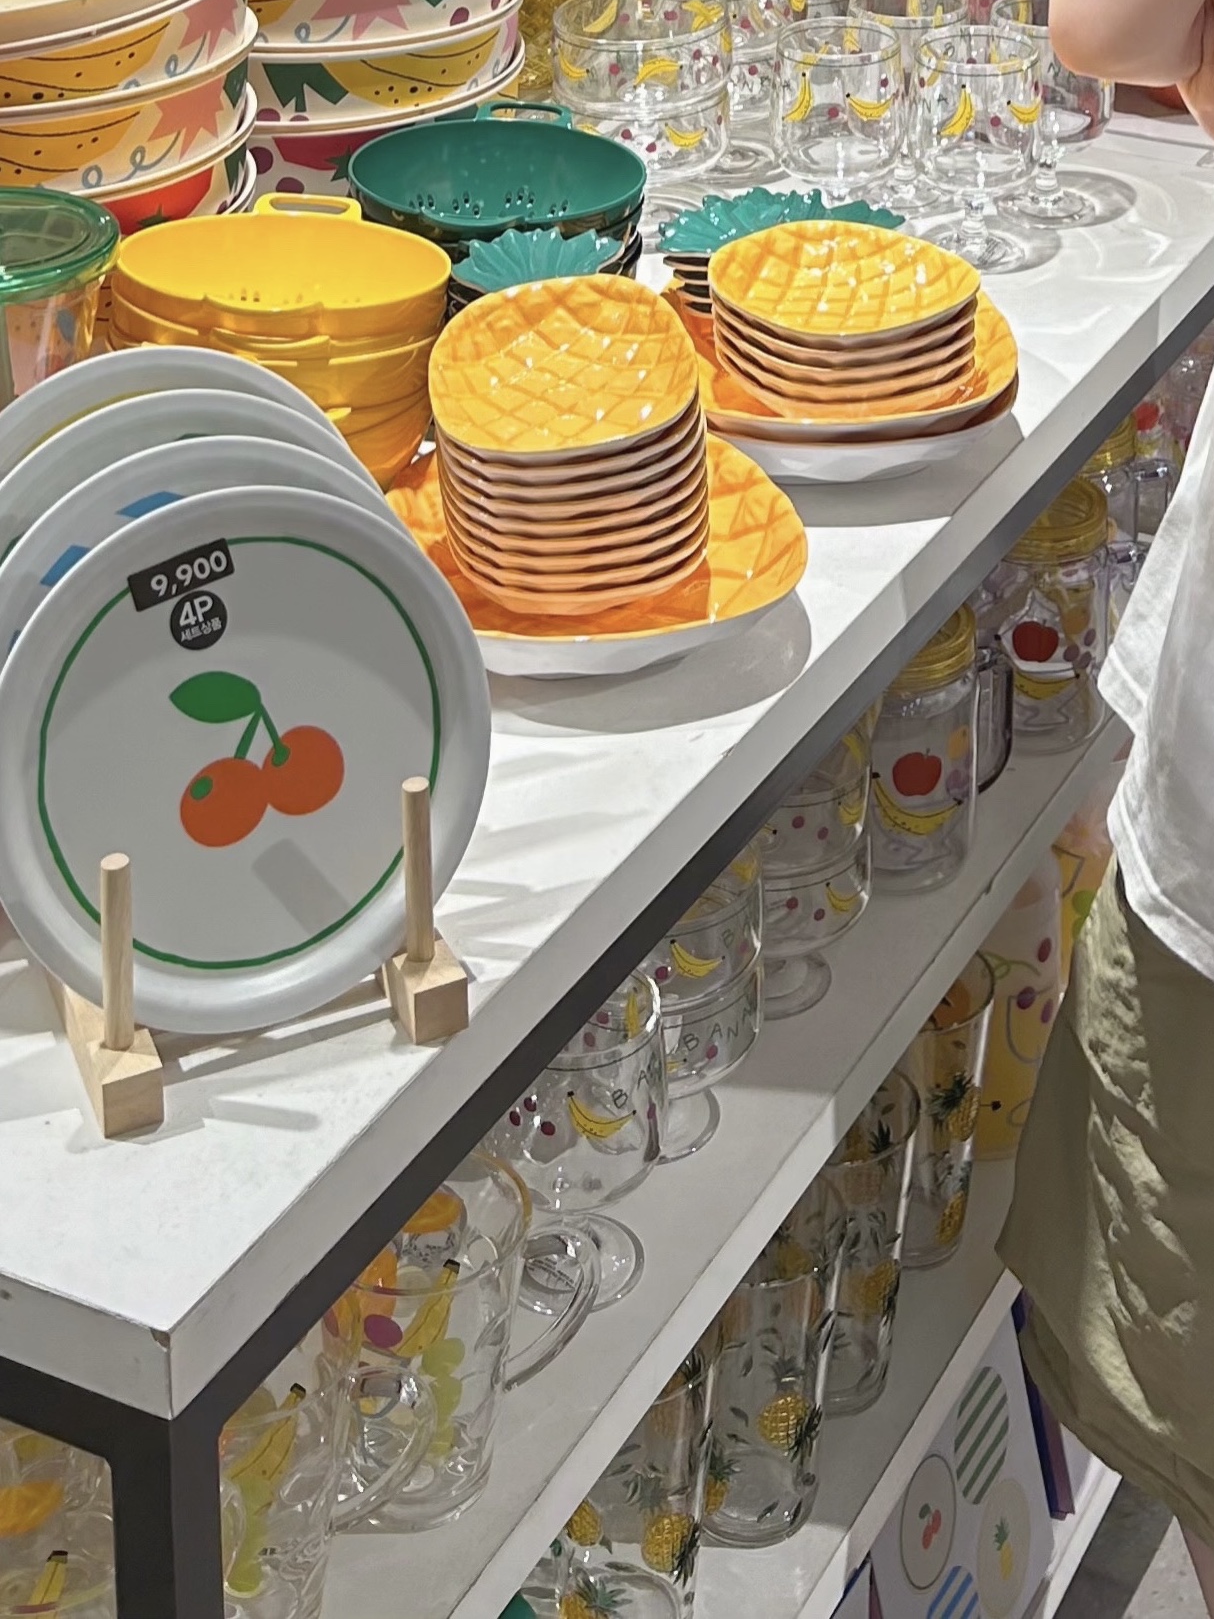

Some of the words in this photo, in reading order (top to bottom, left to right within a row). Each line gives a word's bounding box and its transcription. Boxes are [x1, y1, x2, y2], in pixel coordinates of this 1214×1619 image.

[150, 550, 227, 597] 9,900
[179, 595, 213, 627] 4P
[180, 617, 222, 642] 세트상품
